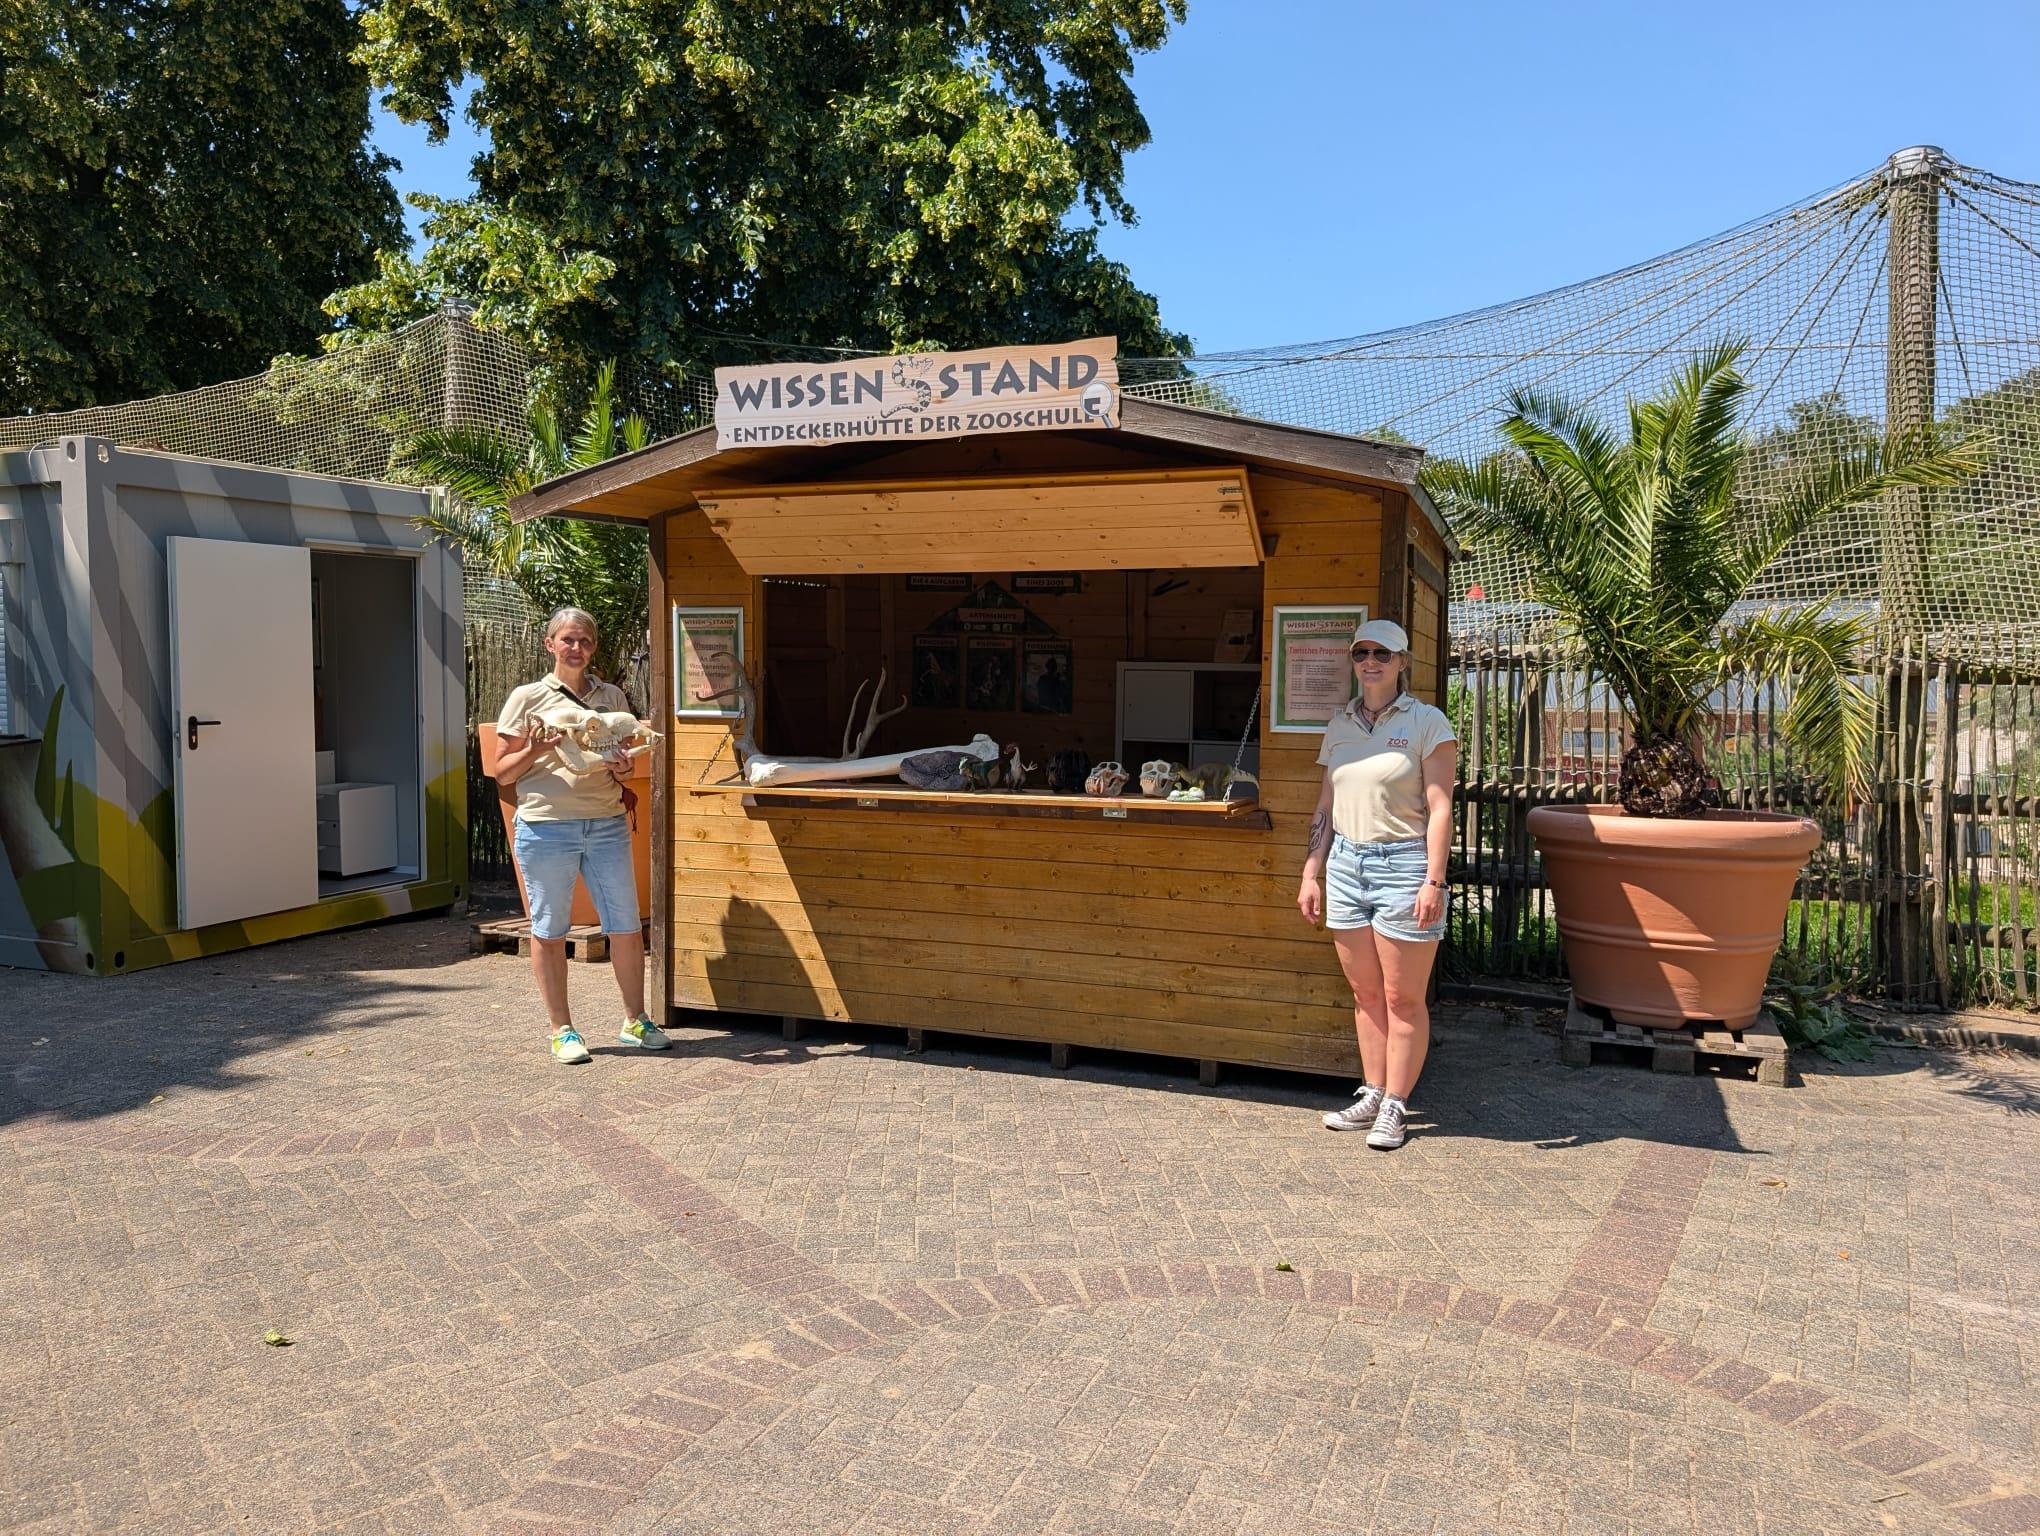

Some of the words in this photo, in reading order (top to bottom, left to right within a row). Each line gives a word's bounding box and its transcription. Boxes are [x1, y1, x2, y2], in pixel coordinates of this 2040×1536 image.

[729, 370, 883, 413] WISSEN
[938, 354, 1099, 399] STAND
[734, 416, 914, 443] ENTDECKERHÜTTE
[920, 415, 961, 433] DER
[966, 405, 1096, 431] ZOOSCHULE
[1286, 621, 1316, 629] WISSEN
[1325, 620, 1354, 628] STAND
